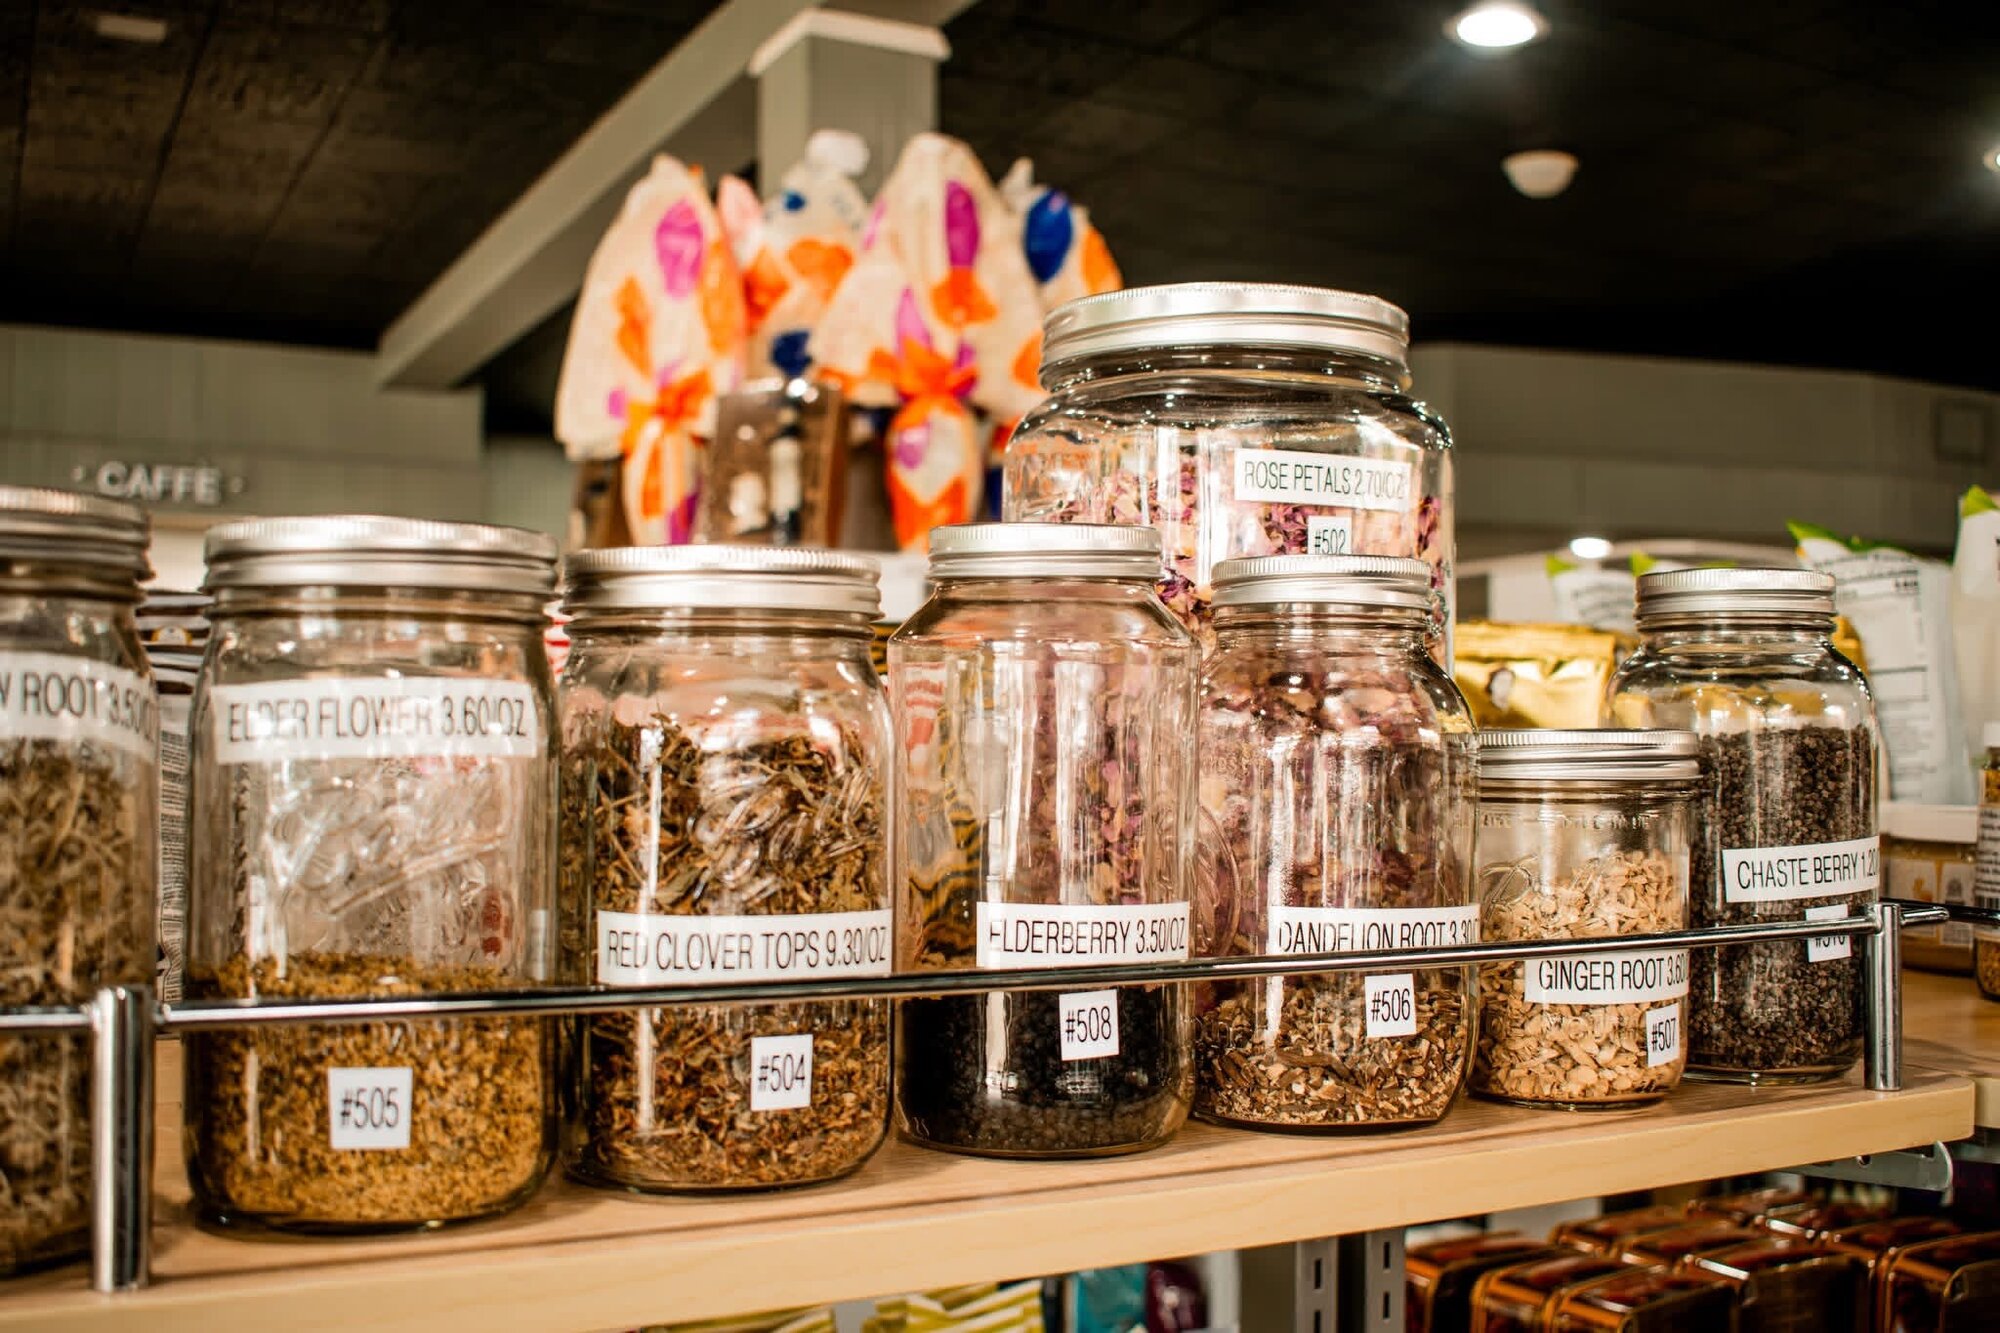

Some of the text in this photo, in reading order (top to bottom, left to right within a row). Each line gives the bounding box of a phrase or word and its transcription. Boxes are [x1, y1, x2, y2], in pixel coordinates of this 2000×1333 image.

[1244, 461, 1404, 500] ROSE PETALS 2.70/OZ
[1314, 529, 1346, 555] #502
[21, 671, 99, 718] ROOT
[229, 695, 527, 743] ELDER FLOWER 3.60/OZ
[1737, 857, 1808, 890] CHASTE
[1813, 852, 1858, 884] BERRY
[608, 926, 887, 971] RED CLOVER TOPS 9.30/OZ
[989, 917, 1186, 954] ELDERBERRY 3.50/OZ
[1279, 921, 1394, 953] DANDELION
[1400, 921, 1446, 948] ROOT
[1538, 960, 1615, 992] GINGER
[1621, 957, 1664, 990] ROOT
[1371, 988, 1411, 1022] #506
[1065, 1006, 1112, 1043] #508
[1651, 1018, 1677, 1052] #507
[758, 1053, 806, 1092] #504
[341, 1087, 400, 1129] #505
